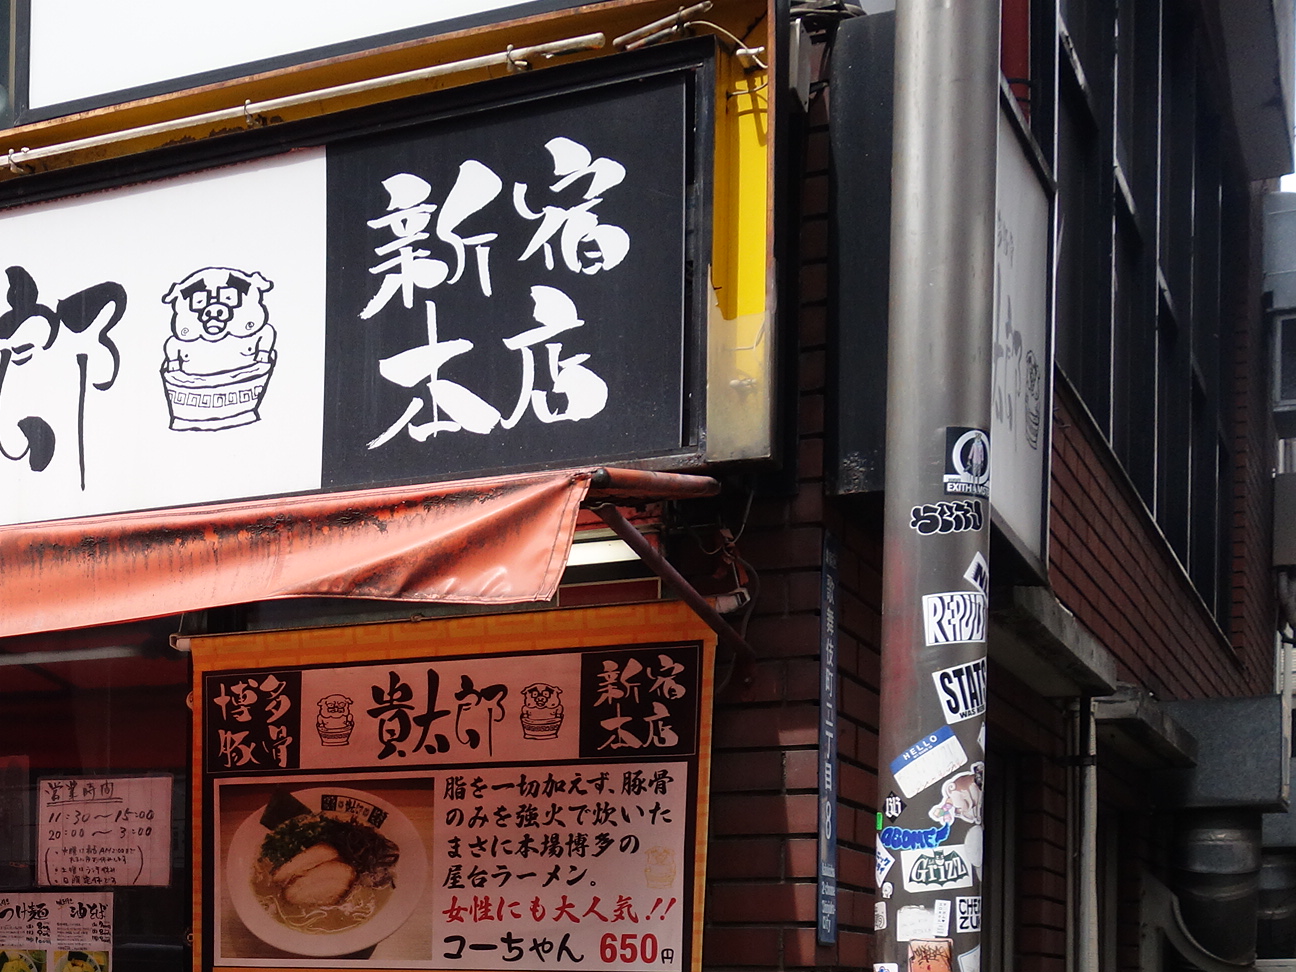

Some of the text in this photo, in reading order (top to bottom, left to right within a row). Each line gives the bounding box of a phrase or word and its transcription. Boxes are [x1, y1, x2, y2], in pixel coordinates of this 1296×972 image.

[360, 136, 630, 319] 新宿
[367, 285, 608, 450] 本店
[214, 674, 294, 726] 博多
[593, 654, 687, 708] 新宿
[366, 668, 510, 761] 貴太郎
[596, 701, 680, 751] 本店
[218, 724, 293, 769] 豚骨
[903, 734, 939, 761] HELLO
[443, 771, 674, 802] 脂を一切加えず、豚骨
[446, 804, 674, 830] のみを強火で炊いた
[824, 800, 832, 840] 8
[445, 833, 640, 858] まさに本場博多の
[442, 863, 601, 891] 屋台ラーメン。
[442, 894, 677, 925] 女性にも大人気!!
[443, 932, 675, 966] コーちゃん 650円
